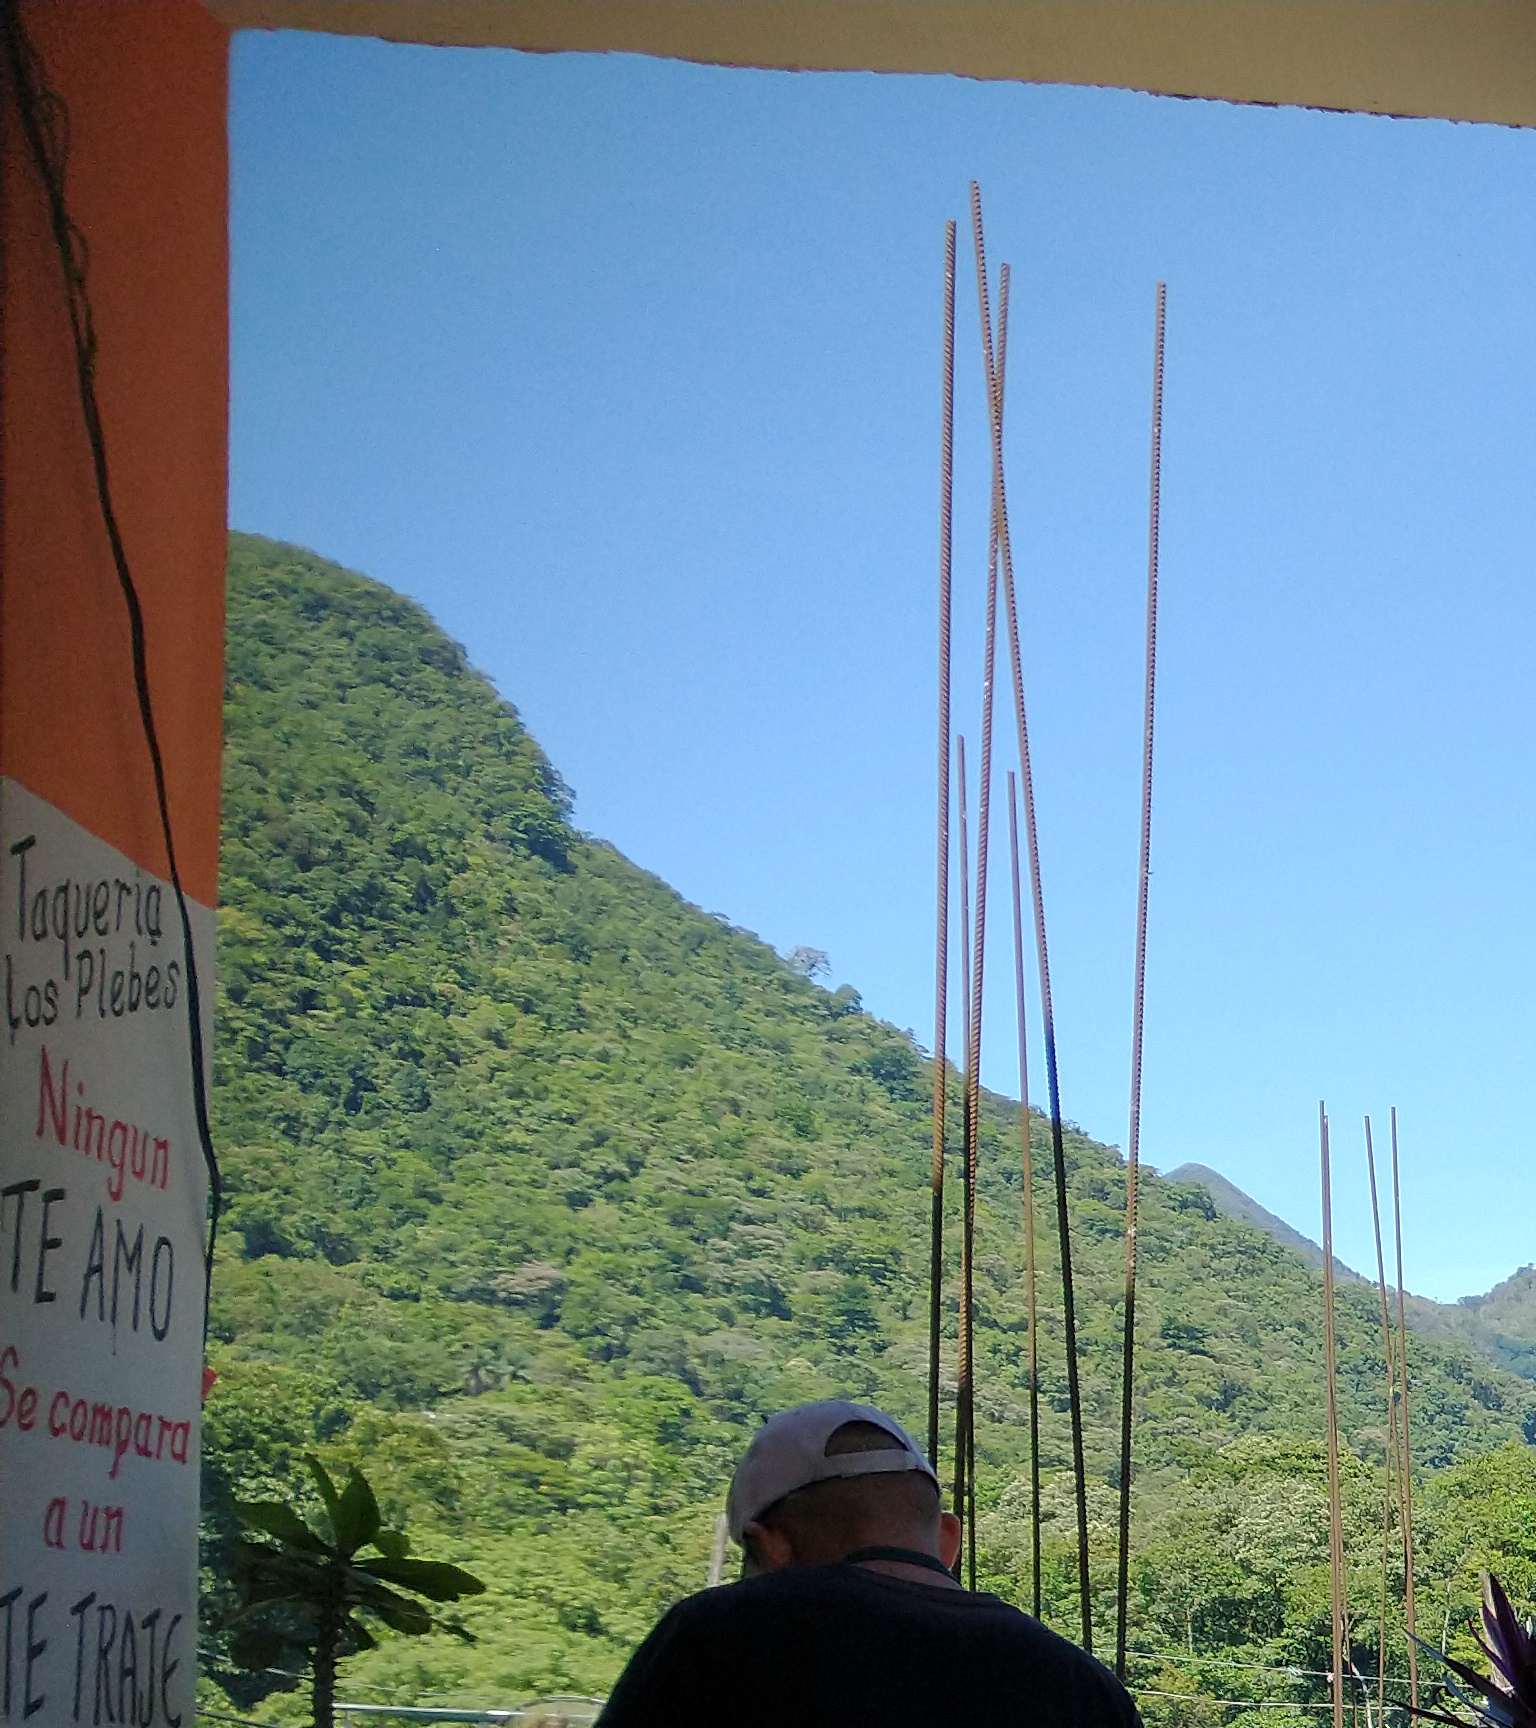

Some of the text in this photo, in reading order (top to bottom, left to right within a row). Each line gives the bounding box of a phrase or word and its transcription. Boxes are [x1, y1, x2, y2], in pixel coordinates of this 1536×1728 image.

[5, 941, 181, 1034] Los Plebes
[36, 1044, 170, 1200] Ningun
[1, 1178, 173, 1342] TE AMO
[0, 1346, 191, 1480] Se compara
[43, 1497, 123, 1553] a un
[0, 1586, 182, 1728] TE TRAJE
